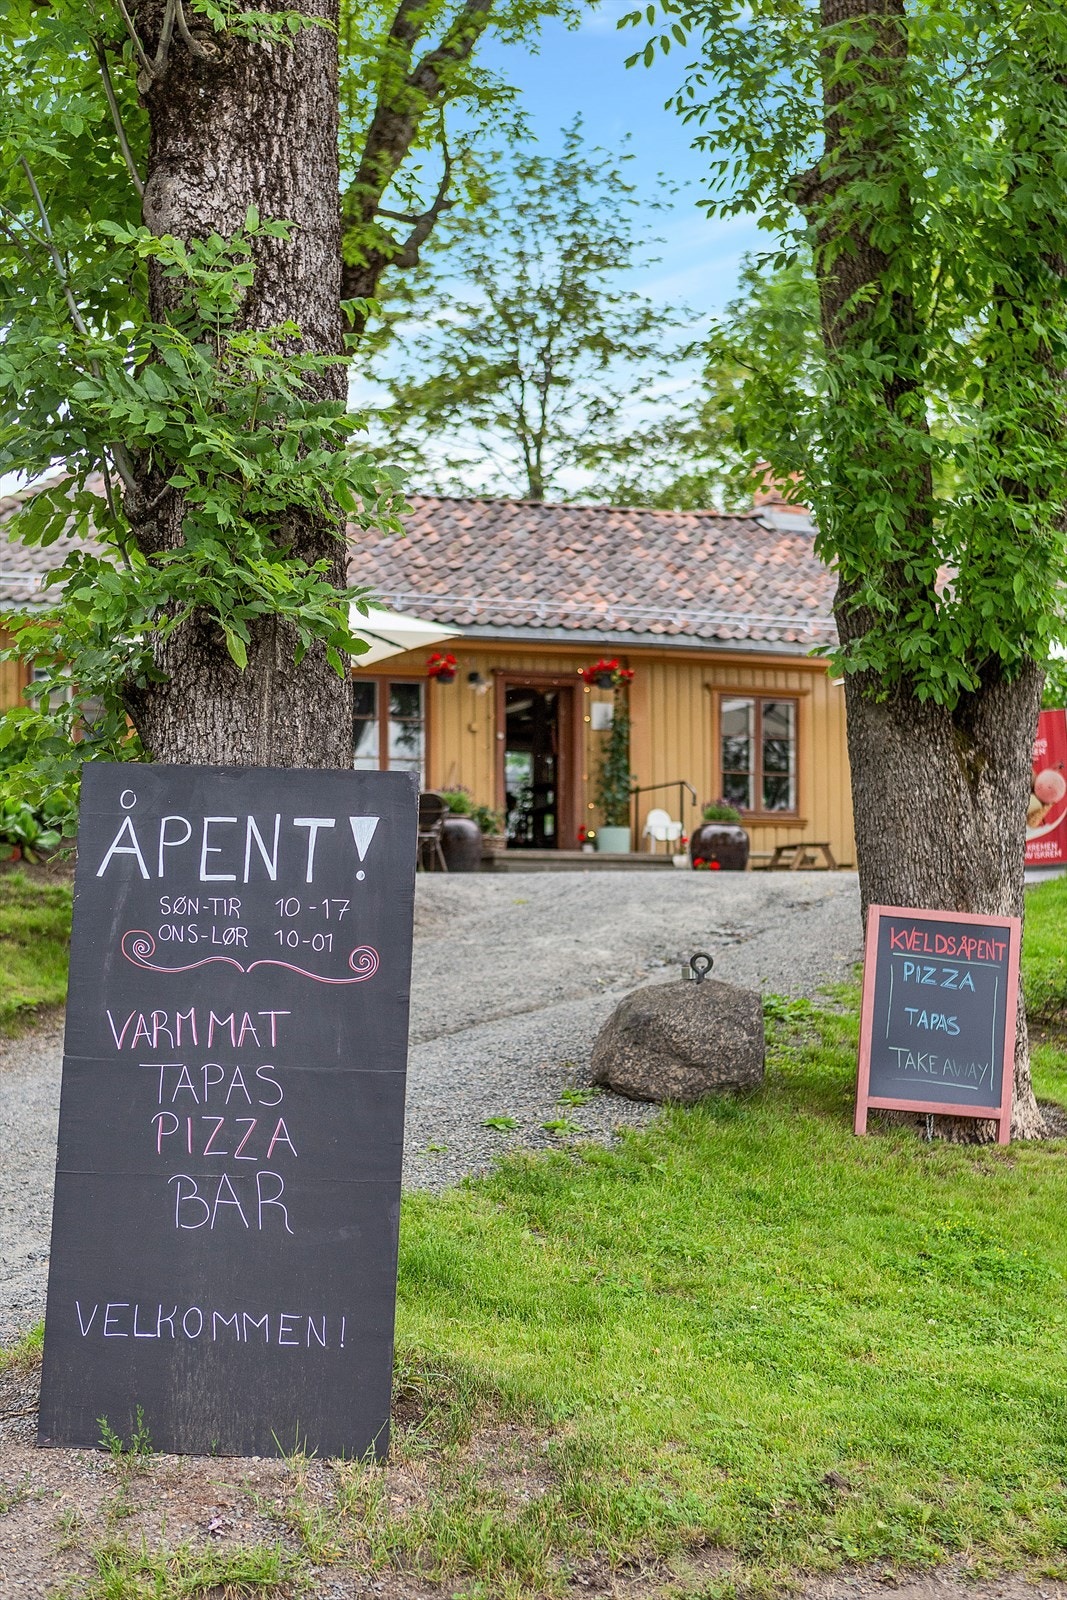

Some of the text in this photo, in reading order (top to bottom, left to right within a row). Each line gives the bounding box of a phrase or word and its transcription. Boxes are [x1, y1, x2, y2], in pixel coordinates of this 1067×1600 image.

[96, 789, 380, 883] ÅPENT!
[159, 895, 242, 919] SØN-TIR
[158, 923, 334, 953] ONS-LØR 10-01
[889, 926, 1007, 961] KVELDSÅPENT
[903, 961, 976, 992] PIZZA
[904, 1007, 961, 1036] TAPAS
[888, 1046, 939, 1075] TAKE
[139, 1063, 284, 1106] TAPAS
[151, 1111, 298, 1160] PIZZA
[167, 1171, 294, 1234] BAR
[75, 1301, 346, 1348] VELKOMMEN!
